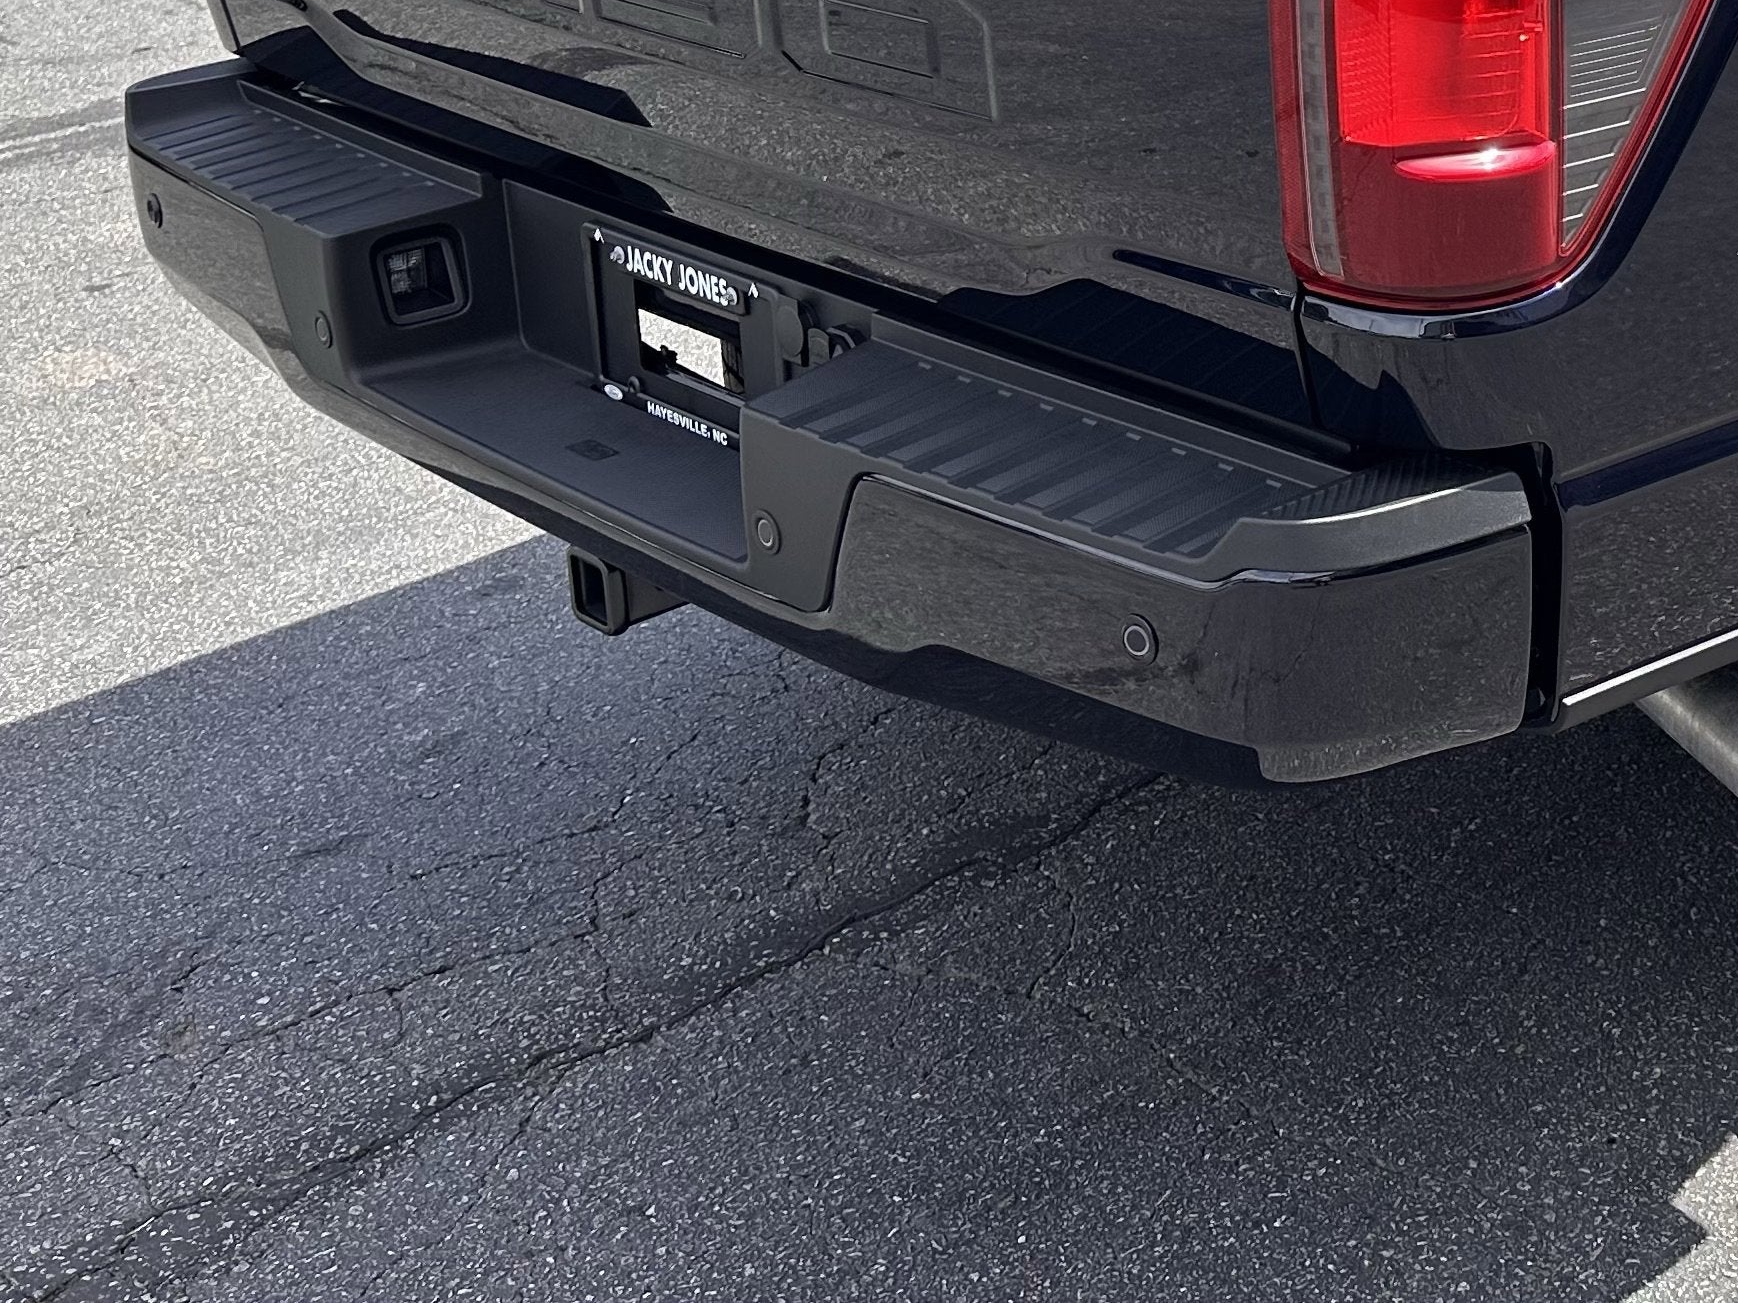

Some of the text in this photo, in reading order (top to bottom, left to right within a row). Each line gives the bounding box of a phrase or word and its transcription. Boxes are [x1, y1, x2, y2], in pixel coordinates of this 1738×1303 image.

[625, 245, 730, 307] JACKY JONES
[646, 400, 728, 447] HAYESVILLE, NC
